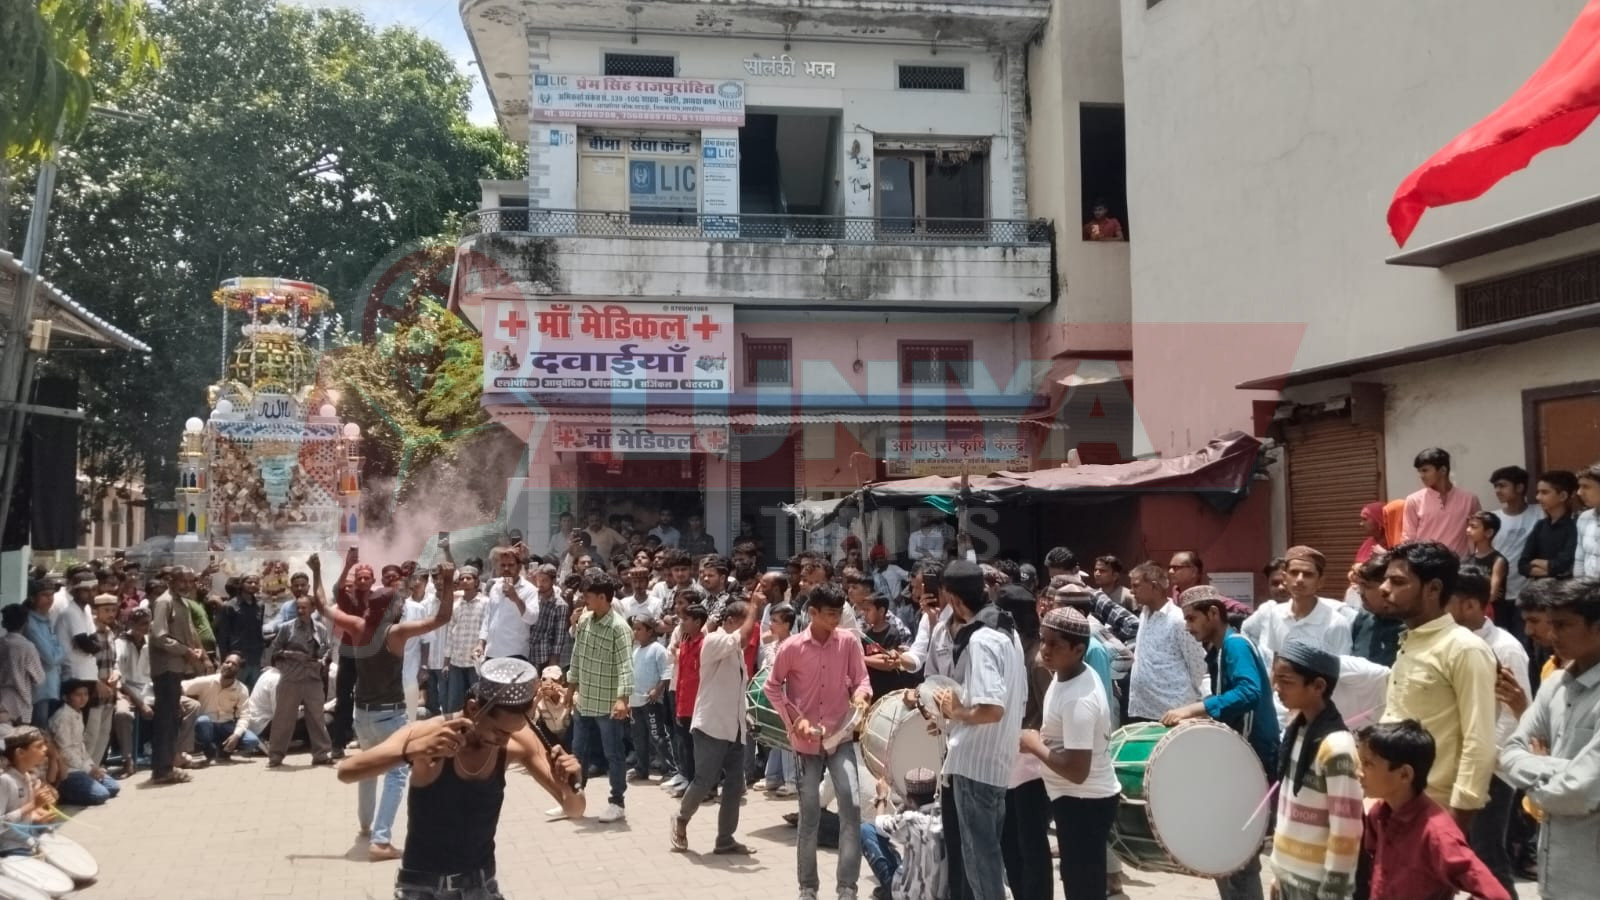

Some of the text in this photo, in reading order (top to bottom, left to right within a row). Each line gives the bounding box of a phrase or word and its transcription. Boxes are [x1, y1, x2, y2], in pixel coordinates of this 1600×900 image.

[550, 76, 568, 86] LIC
[803, 61, 836, 78] भवन
[576, 76, 715, 97] प्रेम सिंह राजपुरोहित
[718, 148, 735, 159] LIC
[660, 164, 696, 192] LIC
[535, 304, 688, 340] माँ मेडिकल
[530, 343, 691, 375] दवाईयाँ
[585, 426, 697, 450] माँ मेडिकल
[959, 434, 987, 457] कृषि
